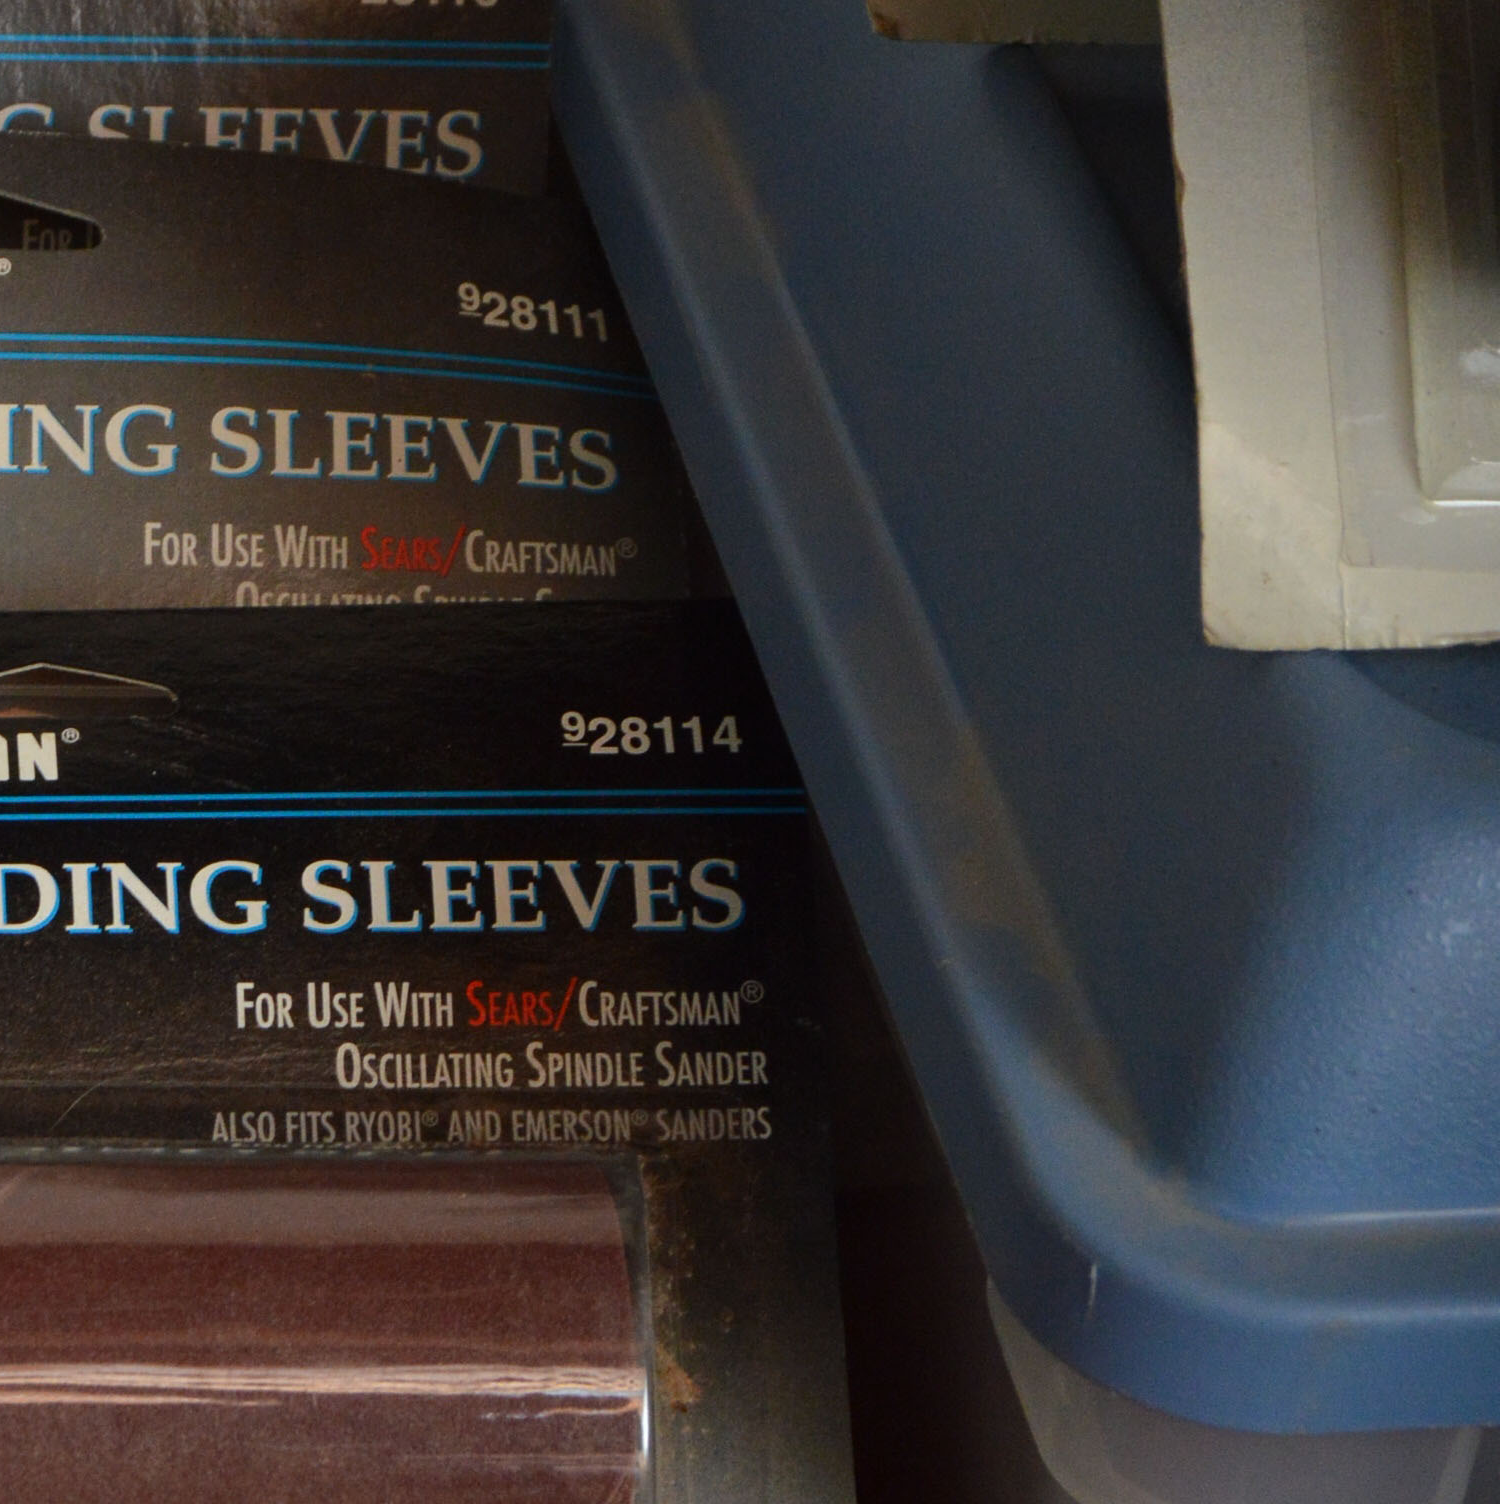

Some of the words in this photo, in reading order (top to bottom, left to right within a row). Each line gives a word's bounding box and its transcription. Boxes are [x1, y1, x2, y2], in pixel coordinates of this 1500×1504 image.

[457, 281, 610, 342] 928111
[206, 402, 622, 496] SLEEVES
[560, 709, 742, 755] 928114
[298, 854, 750, 938] SLEEVES
[335, 1042, 514, 1089] OSCILLATING
[525, 1040, 644, 1089] SPINDLE
[654, 1040, 768, 1087] SANDER
[212, 1108, 277, 1146] ALSO
[284, 1108, 338, 1146] FITS
[446, 1108, 502, 1146] AND
[654, 1104, 774, 1144] SANDERS
